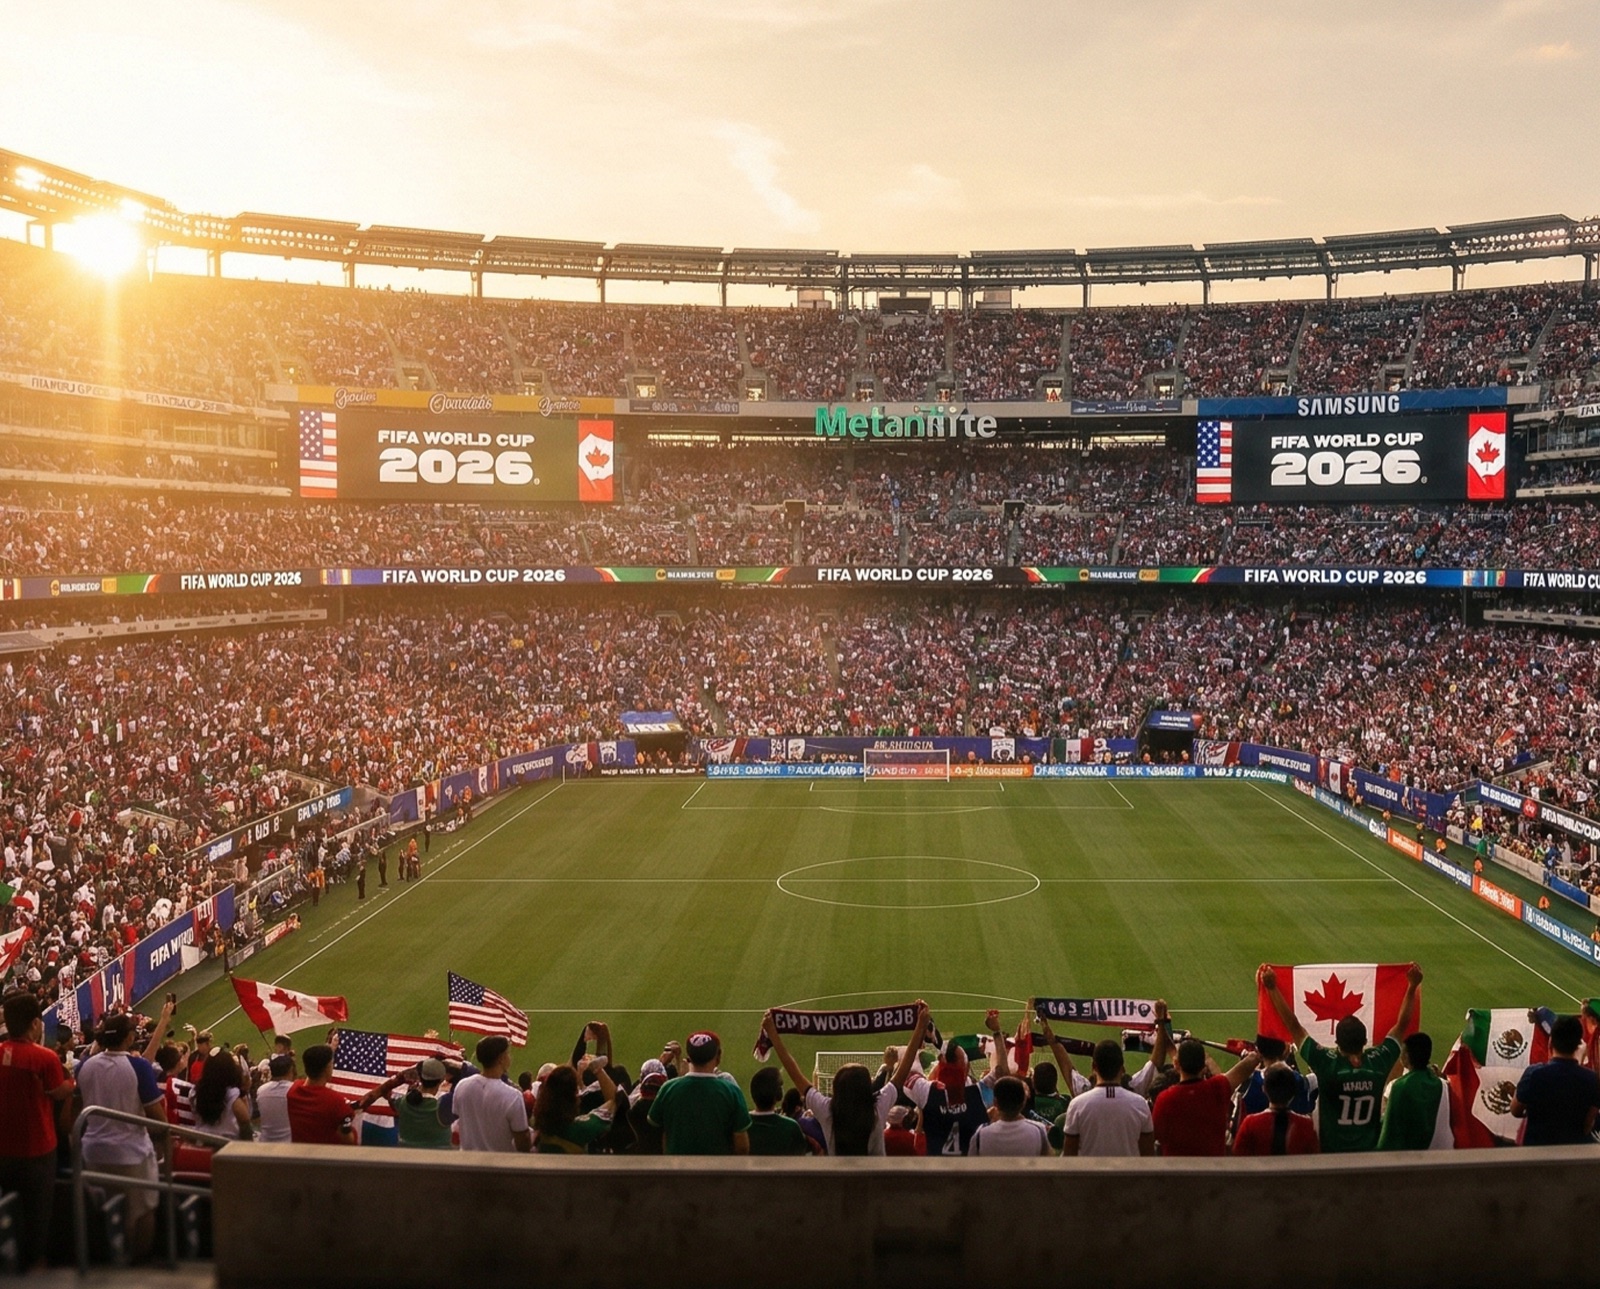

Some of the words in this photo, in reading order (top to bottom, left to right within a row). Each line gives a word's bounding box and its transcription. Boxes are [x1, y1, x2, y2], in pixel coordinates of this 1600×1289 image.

[1297, 394, 1400, 417] SAMSUNG
[377, 430, 420, 444] FIFA
[422, 431, 491, 446] WORLD
[495, 433, 535, 447] CUP
[1271, 435, 1310, 449] FIFA
[1313, 433, 1380, 448] WORLD
[1383, 432, 1424, 447] CUP
[379, 448, 533, 485] 2026
[1270, 449, 1421, 486] 2026
[181, 575, 207, 590] FIFA
[208, 574, 248, 589] WORLD
[250, 573, 272, 588] CUP
[274, 572, 301, 586] 2026
[382, 569, 418, 583] FIFA
[420, 569, 484, 583] WORLD
[486, 569, 519, 583] CUP
[522, 569, 566, 582] 2026
[817, 569, 851, 582] FIFA
[853, 569, 913, 582] WORLD
[916, 569, 949, 582] CUP
[952, 569, 993, 582] 2026
[1244, 569, 1279, 583] FIFA
[1281, 570, 1342, 584] WORLD
[1346, 570, 1380, 584] CUP
[1383, 570, 1427, 584] 2026
[1547, 573, 1586, 588] WORLD
[150, 942, 170, 971] FIFA
[812, 1014, 869, 1031] WORLD
[1337, 1094, 1375, 1126] 10
